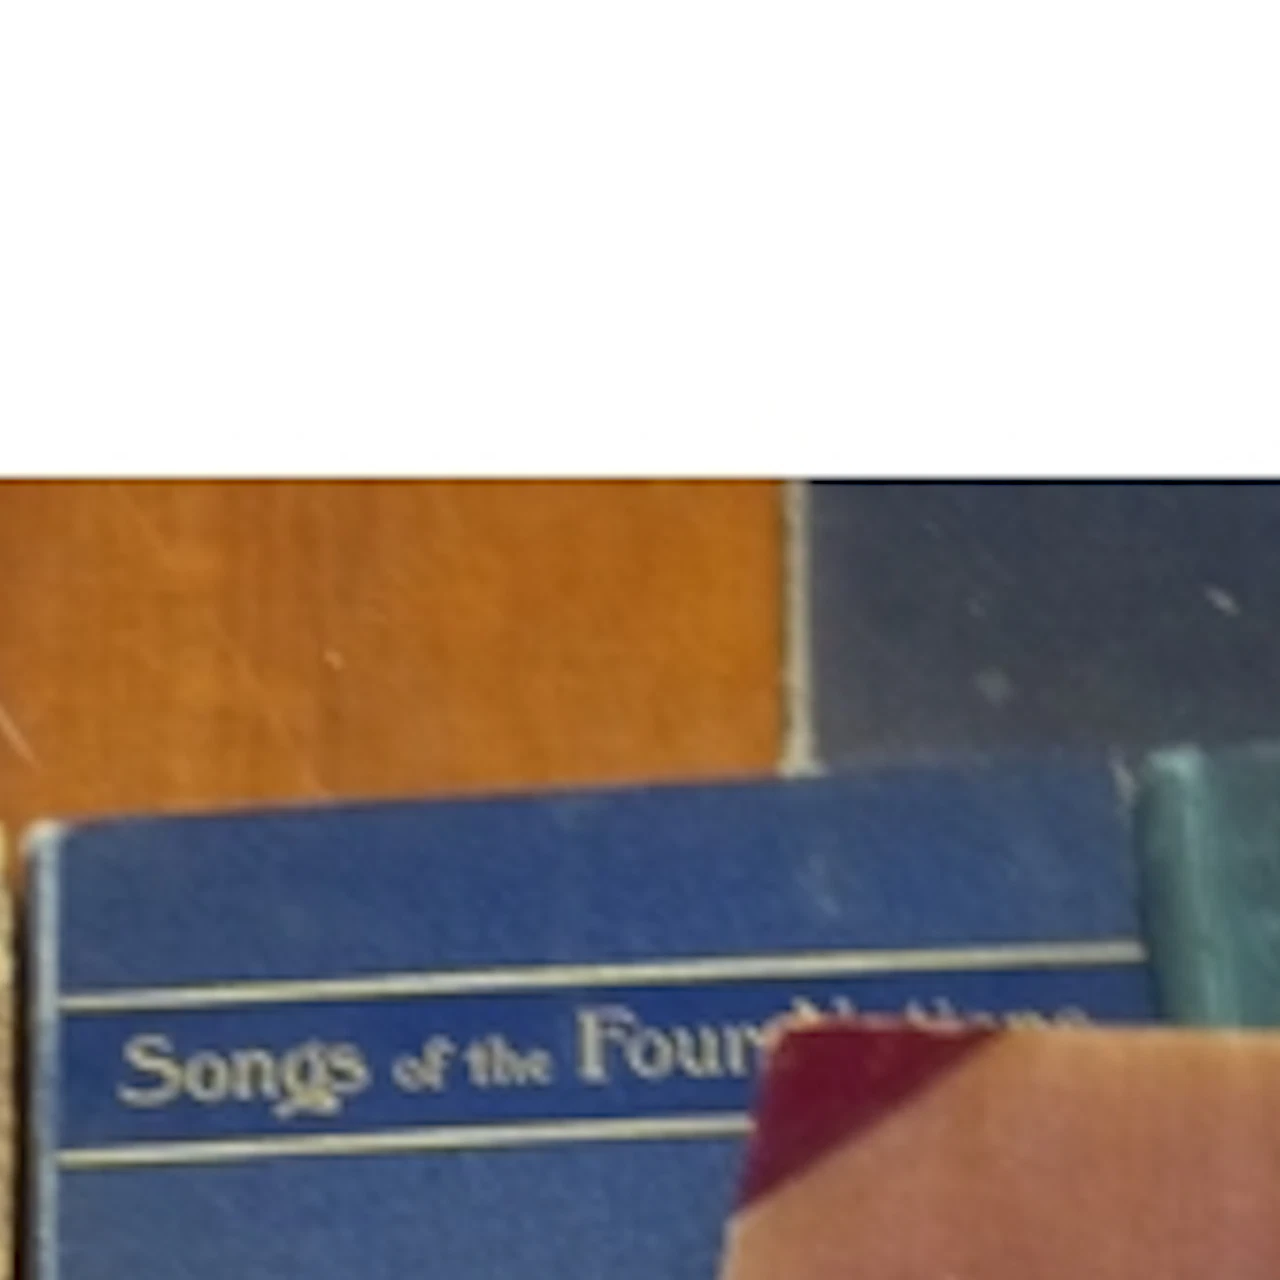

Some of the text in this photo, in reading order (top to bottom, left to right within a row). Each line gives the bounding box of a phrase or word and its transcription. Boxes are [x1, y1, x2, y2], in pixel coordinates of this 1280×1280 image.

[119, 1030, 369, 1120] Songs
[392, 1039, 456, 1092] of
[463, 1037, 554, 1088] the
[576, 1004, 768, 1085] Four
